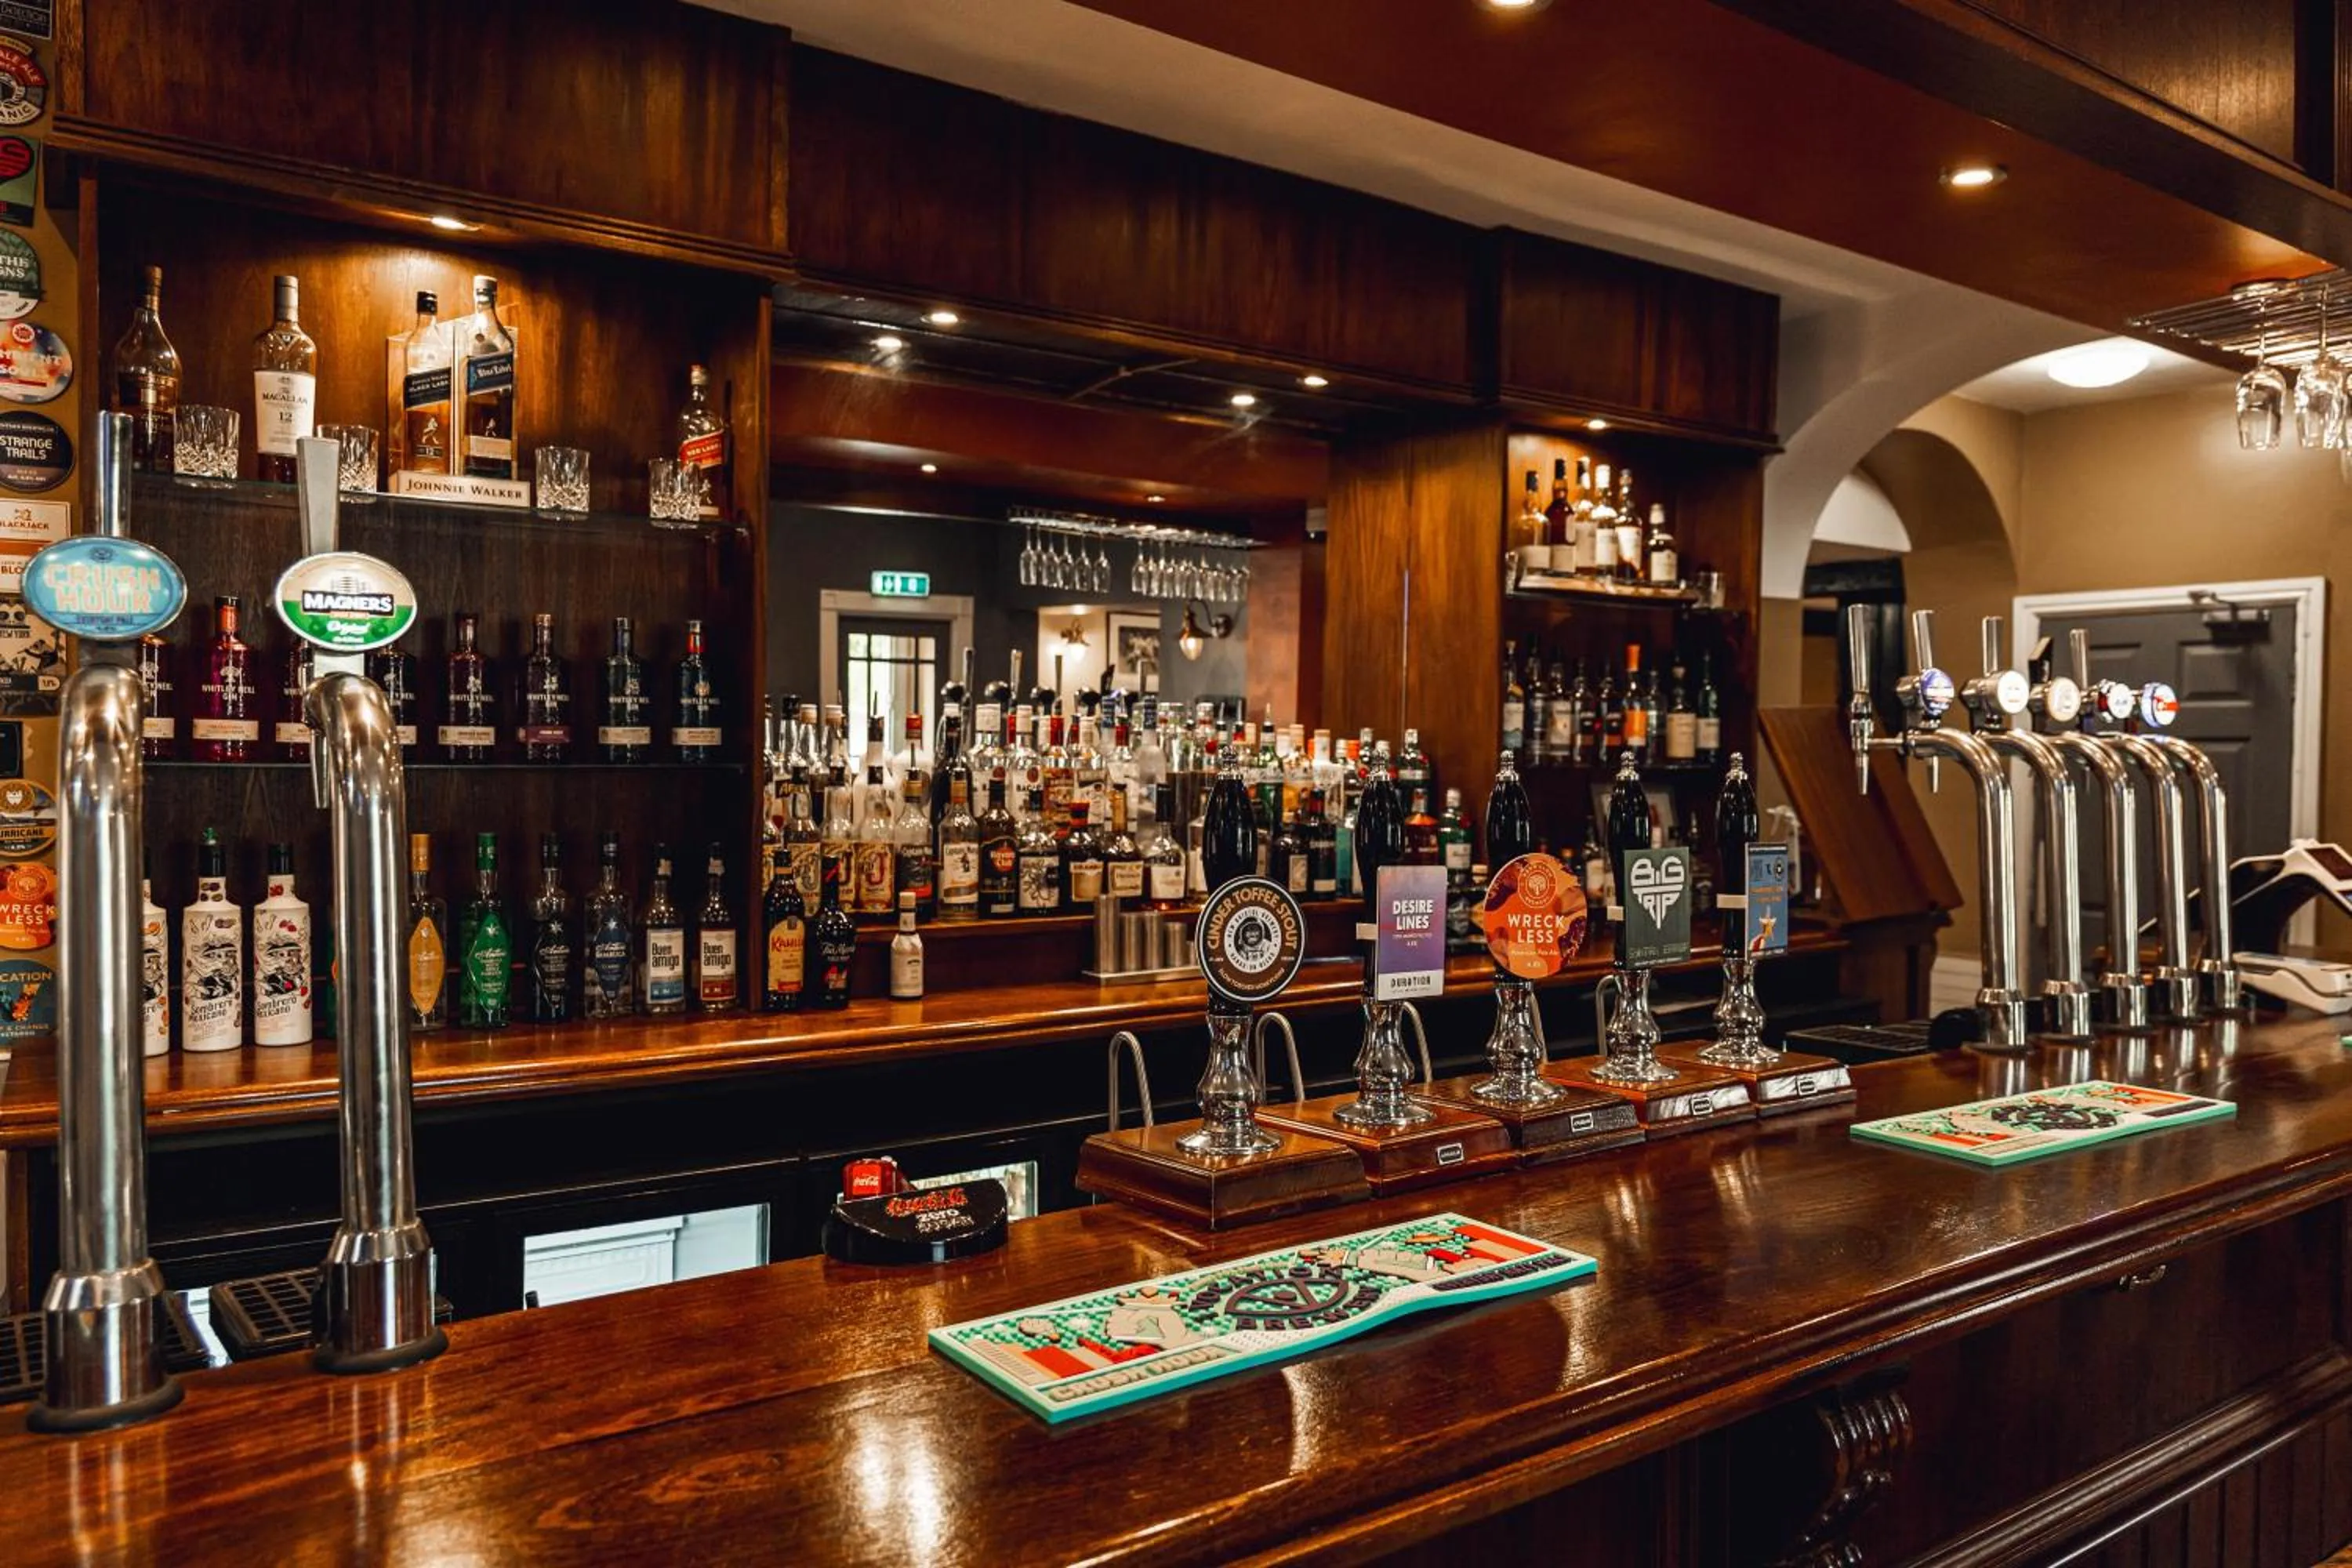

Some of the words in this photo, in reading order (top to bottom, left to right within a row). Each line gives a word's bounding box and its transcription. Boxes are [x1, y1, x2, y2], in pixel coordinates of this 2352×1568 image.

[0, 435, 53, 449] STRANGE
[6, 446, 47, 460] TRAILS
[406, 478, 465, 494] JOHNNIE
[470, 485, 523, 499] WALKER
[0, 521, 49, 530] LACKJACK
[56, 584, 152, 614] HOUR
[303, 593, 392, 612] MAGNERS
[1630, 855, 1685, 887] BIG
[0, 904, 56, 915] WRECK
[1392, 899, 1434, 915] DESIRE
[1631, 883, 1684, 930] TRIP
[5, 914, 44, 925] LESS
[1207, 898, 1236, 950] CINDER
[1232, 887, 1280, 909] TOFFEE
[1276, 903, 1298, 950] STOUT
[1396, 915, 1430, 931] LINES
[1507, 913, 1565, 928] WRECK
[1517, 929, 1555, 944] LESS
[0, 971, 52, 982] CATION
[1391, 975, 1431, 988] DURATION
[1188, 1262, 1344, 1312] VOCATION
[1235, 1285, 1384, 1330] BREWERY
[1050, 1372, 1149, 1402] CRUSH
[1145, 1346, 1230, 1375] HOUR
